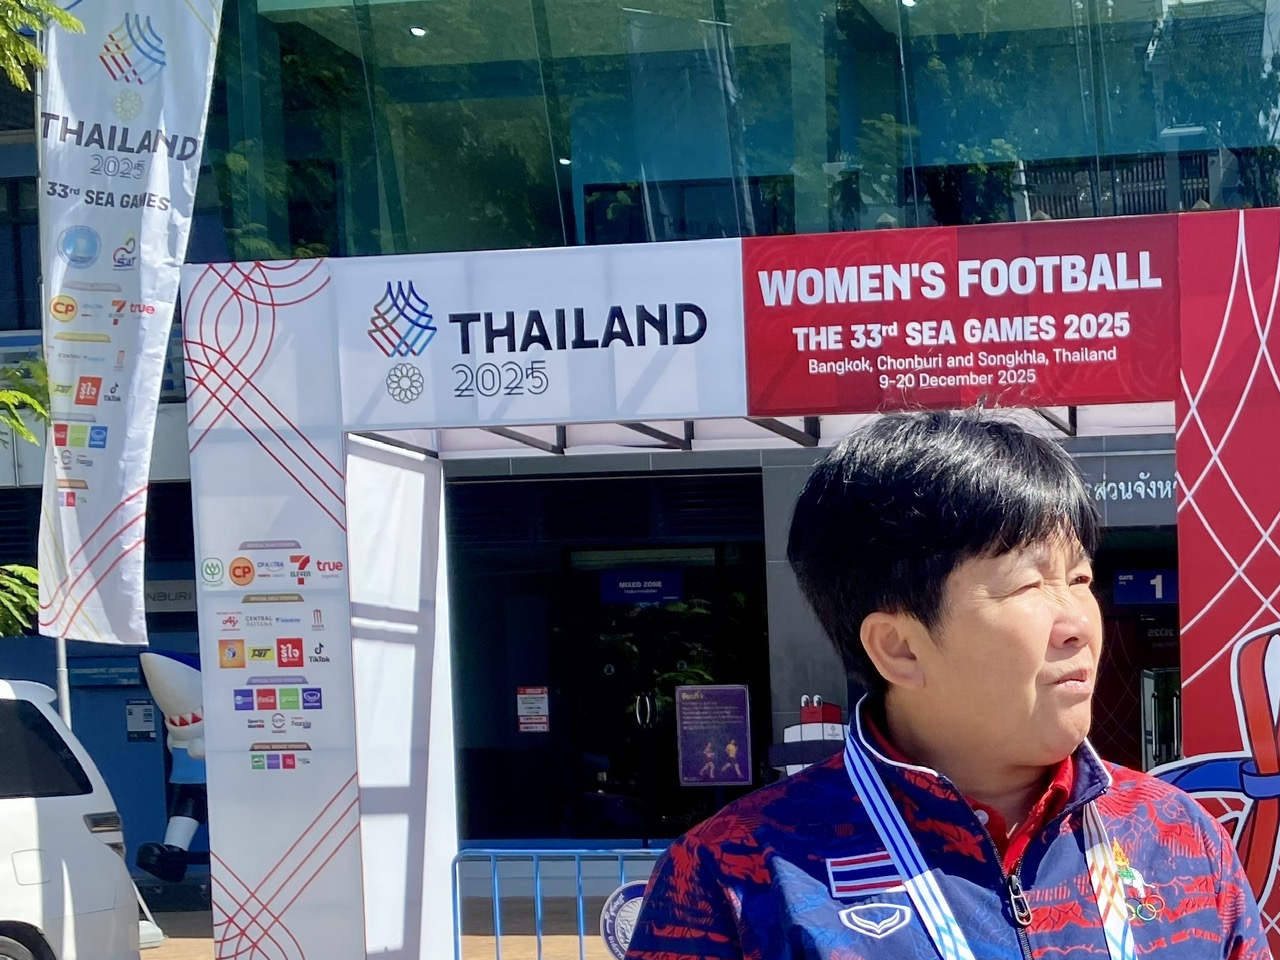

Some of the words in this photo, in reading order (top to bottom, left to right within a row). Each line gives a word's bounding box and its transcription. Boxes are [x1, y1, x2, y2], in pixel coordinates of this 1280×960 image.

[41, 112, 198, 161] THAILAND
[90, 154, 146, 179] 2025
[47, 181, 80, 198] 33rd
[84, 189, 115, 208] SEA
[120, 192, 171, 211] GAMES
[757, 261, 946, 307] WOMEN'S
[958, 250, 1163, 298] FOOTBALL
[53, 302, 75, 315] CP
[130, 302, 156, 314] true
[448, 302, 708, 354] THAILAND
[792, 325, 843, 351] THE
[850, 321, 898, 349] 33rd
[905, 319, 957, 346] SEA
[963, 315, 1057, 344] GAMES
[1063, 311, 1131, 340] 2025
[808, 356, 874, 375] Bangkok,
[877, 353, 943, 371] Chonburi
[946, 352, 974, 367] and
[978, 349, 1049, 368] Songkhla,
[1052, 345, 1118, 363] Thailand
[451, 359, 549, 397] 2025
[919, 371, 993, 387] December
[997, 368, 1036, 385] 2025
[1093, 471, 1177, 501] ส่วนจังห
[232, 566, 251, 578] CP
[316, 560, 343, 571] true
[1150, 574, 1163, 599] 1
